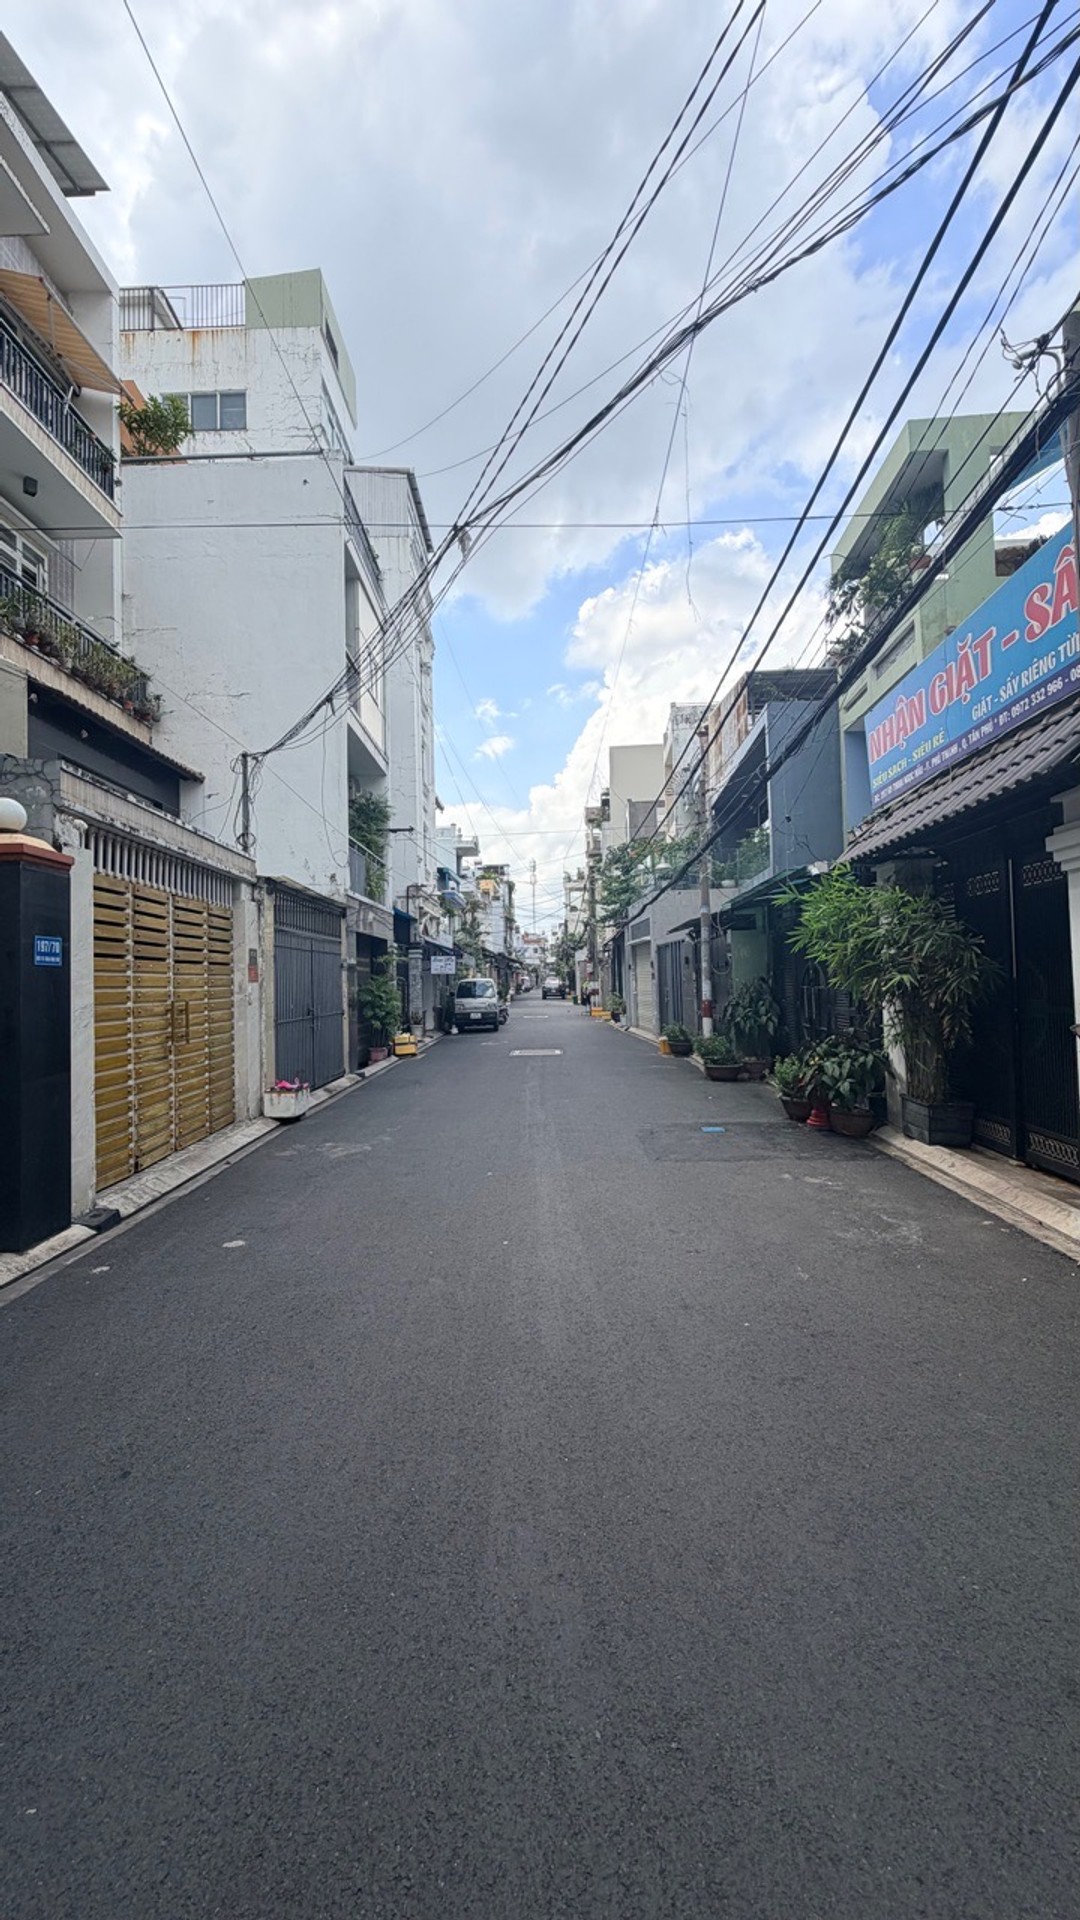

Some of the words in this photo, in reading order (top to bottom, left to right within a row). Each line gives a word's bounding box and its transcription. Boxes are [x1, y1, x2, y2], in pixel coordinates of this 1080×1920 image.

[868, 688, 927, 765] NHẬN
[929, 626, 996, 715] GIẶT
[1001, 629, 1019, 651] -
[972, 694, 993, 721] GIẶT
[1000, 671, 1020, 702] SẤY
[1021, 651, 1056, 688] RIÊNG
[1030, 687, 1046, 706] 332
